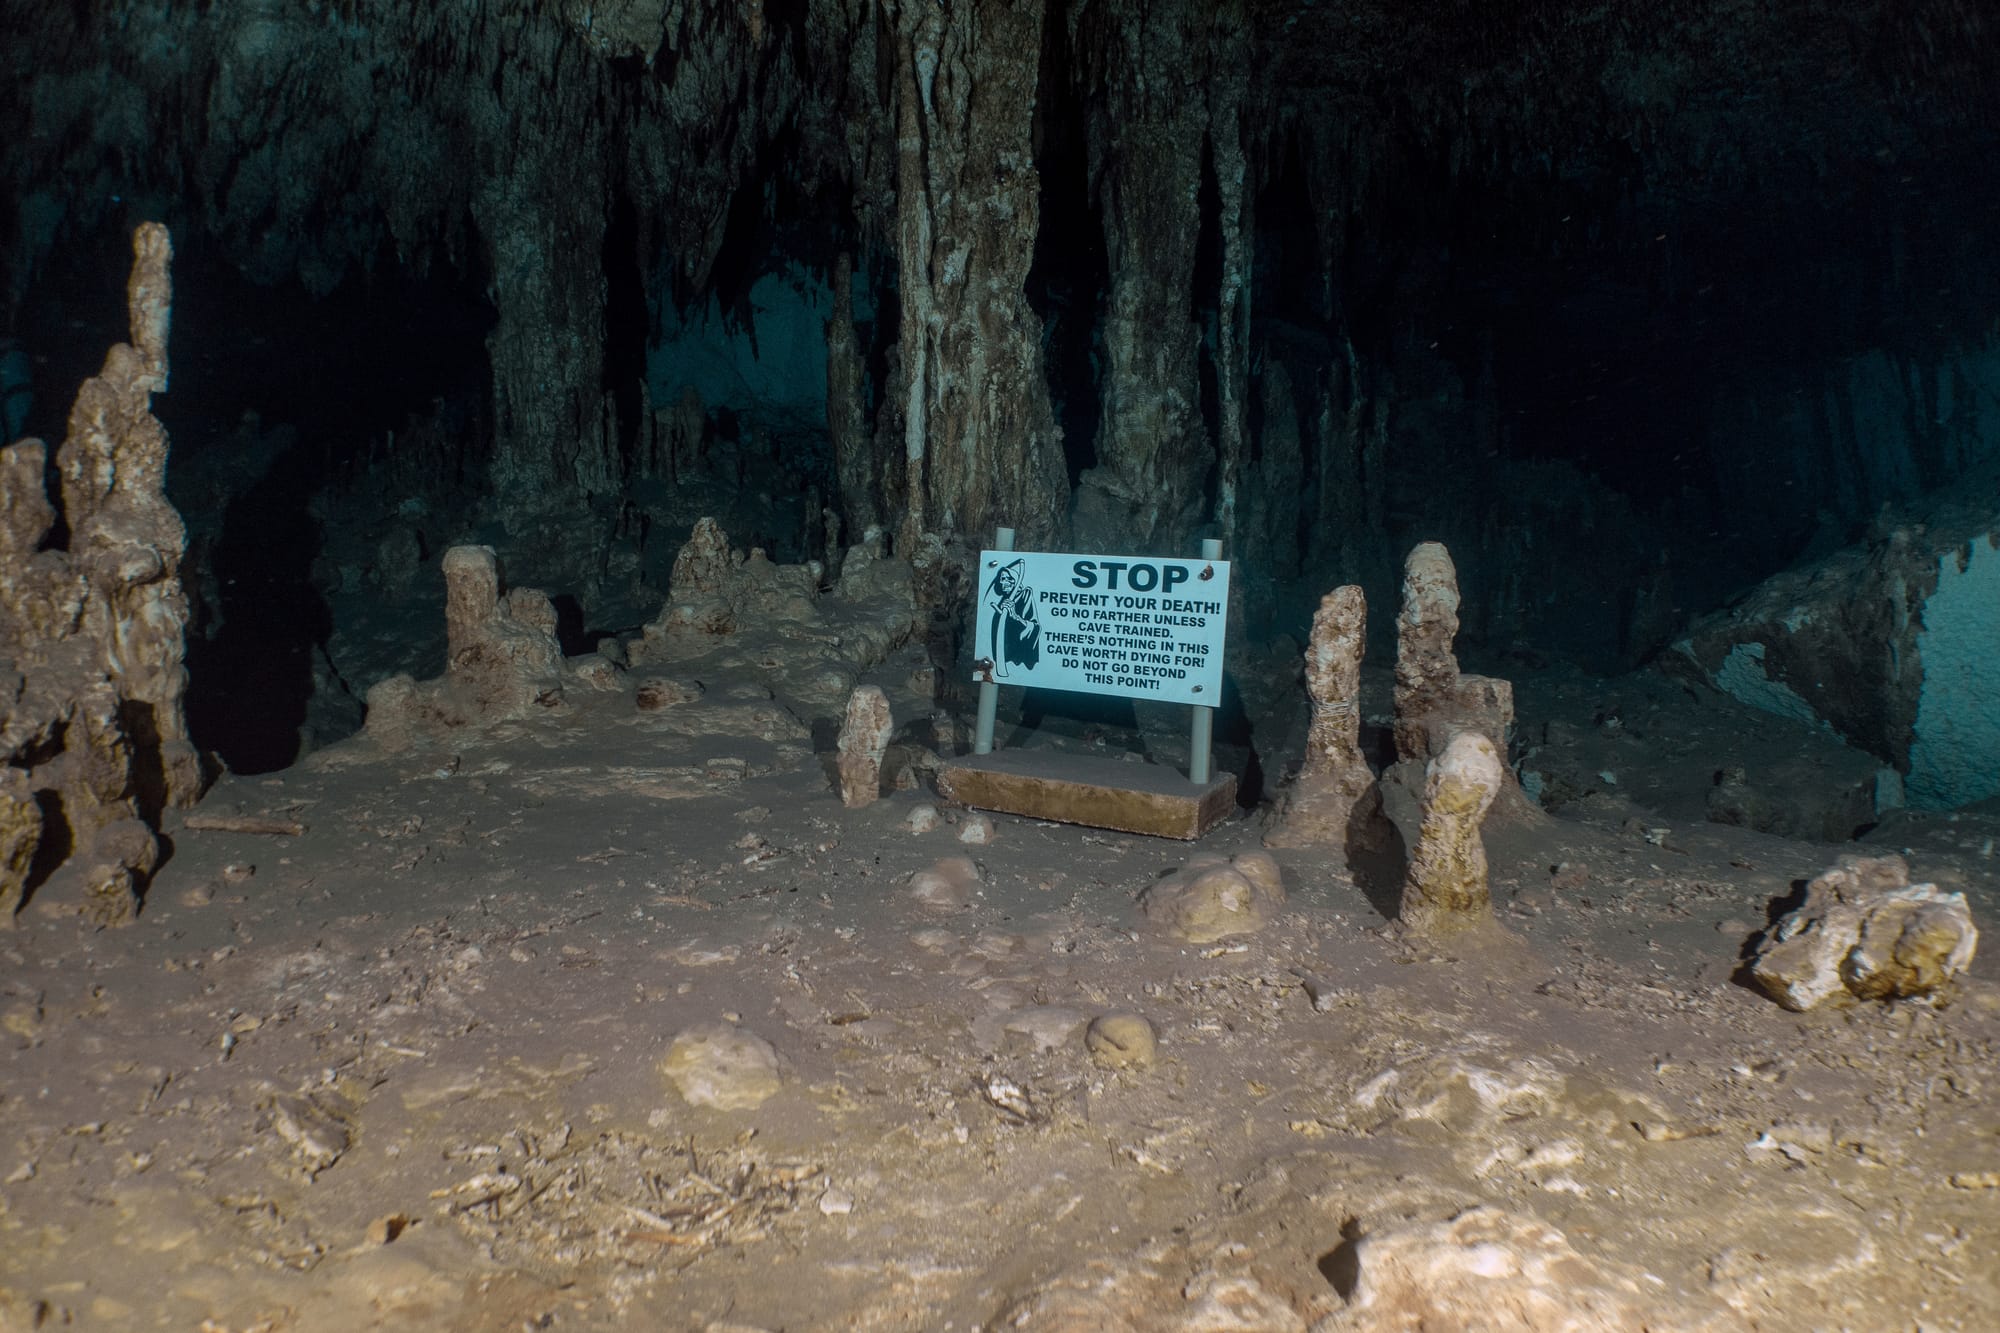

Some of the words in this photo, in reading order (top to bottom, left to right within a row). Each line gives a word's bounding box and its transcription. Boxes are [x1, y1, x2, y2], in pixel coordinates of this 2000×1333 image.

[1072, 561, 1189, 593] STOP
[1040, 592, 1110, 607] PREVENT
[1115, 596, 1157, 610] YOUR
[1162, 599, 1220, 615] DEATH!
[1051, 607, 1068, 617] GO
[1073, 609, 1090, 618] NO
[1093, 610, 1151, 623] FARTHER
[1155, 614, 1206, 627] UNLESS
[1079, 622, 1110, 633] CAVE
[1115, 624, 1173, 638] TRAINED.
[1045, 632, 1095, 645] THERE'S
[1099, 636, 1156, 650] NOTHING
[1161, 642, 1174, 651] IN
[1178, 644, 1209, 655] THIS
[1047, 644, 1078, 656] CAVE
[1082, 648, 1126, 660] WORTH
[1131, 652, 1171, 665] DYING
[1175, 656, 1204, 668] FOR!
[1062, 658, 1079, 668] DO
[1083, 661, 1108, 671] NOT
[1112, 663, 1129, 674] GO
[1134, 665, 1186, 679] BEYOND
[1085, 673, 1113, 685] THIS
[1118, 677, 1160, 689] POINT!
